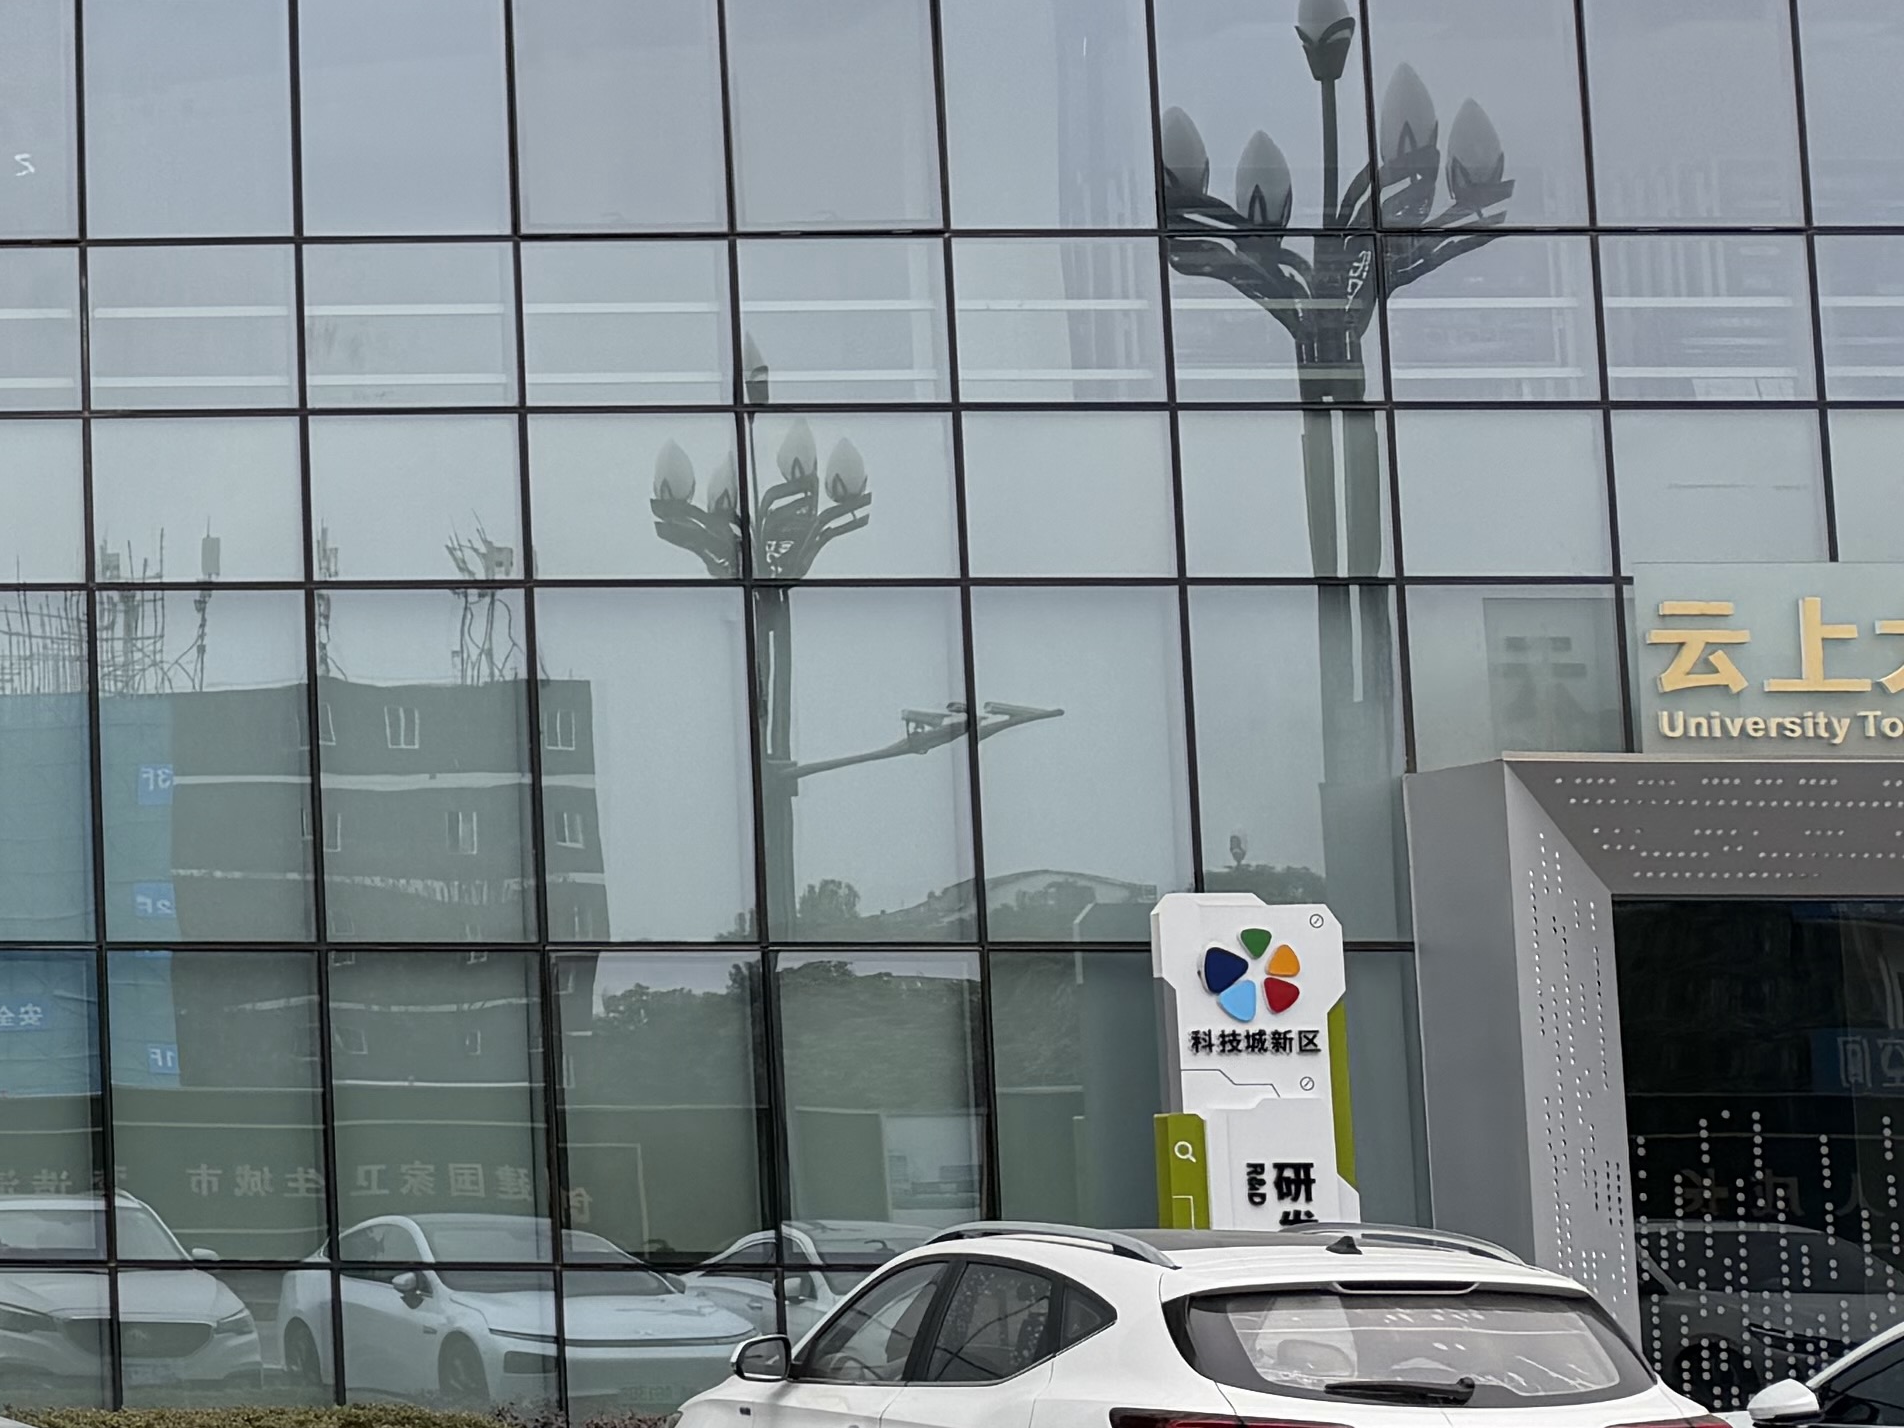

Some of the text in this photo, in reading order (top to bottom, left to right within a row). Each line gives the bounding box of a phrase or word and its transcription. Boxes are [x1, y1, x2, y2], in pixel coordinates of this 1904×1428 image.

[1658, 710, 1851, 745] University
[1190, 1028, 1322, 1055] 科技城新区
[1245, 1163, 1267, 1207] R&D
